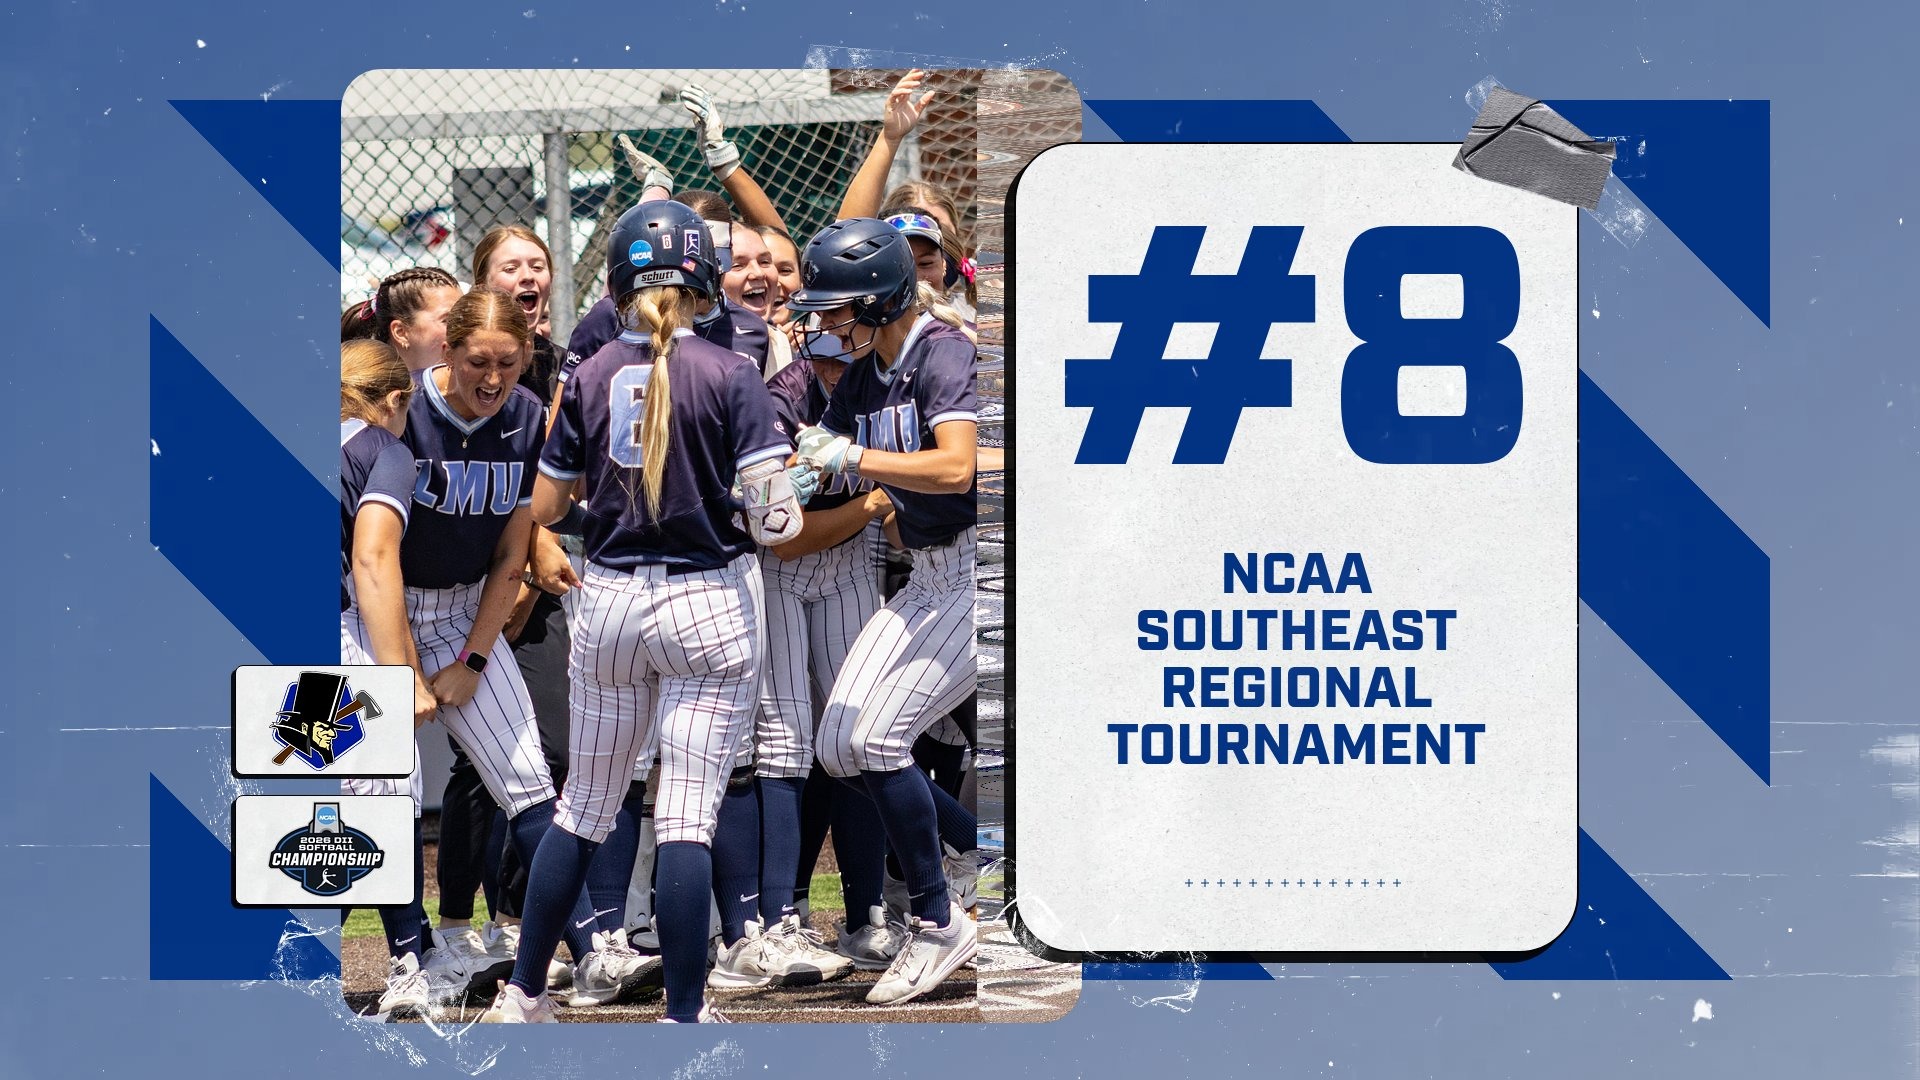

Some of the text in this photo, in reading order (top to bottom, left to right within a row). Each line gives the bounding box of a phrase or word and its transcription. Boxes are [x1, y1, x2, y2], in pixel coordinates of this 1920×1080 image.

[663, 236, 671, 248] 6
[631, 251, 653, 261] NCAA
[641, 271, 674, 282] schutt
[413, 458, 524, 518] LMU
